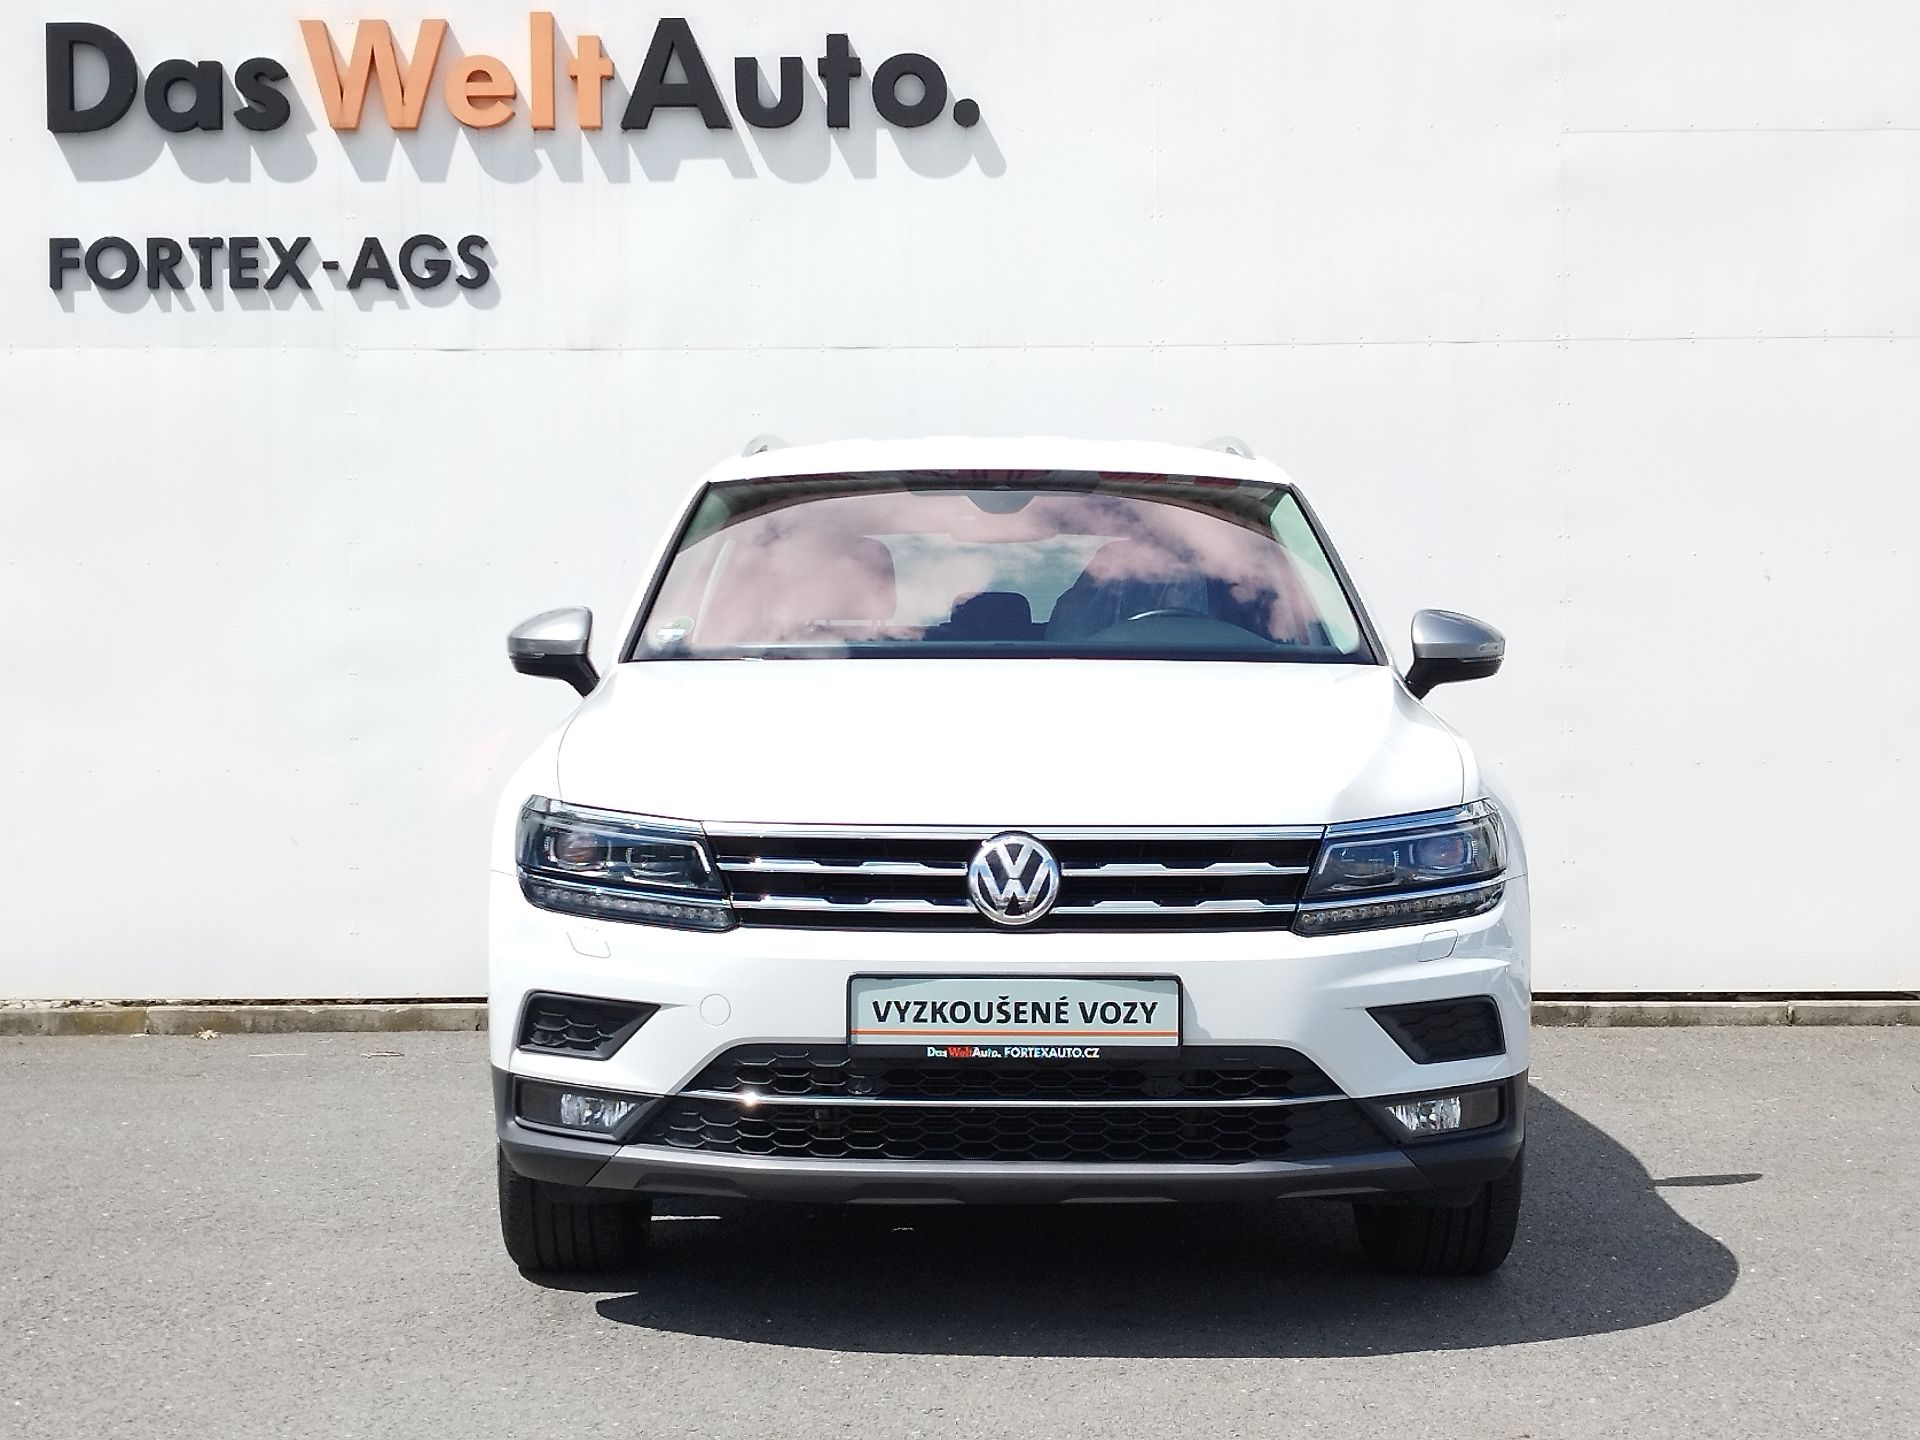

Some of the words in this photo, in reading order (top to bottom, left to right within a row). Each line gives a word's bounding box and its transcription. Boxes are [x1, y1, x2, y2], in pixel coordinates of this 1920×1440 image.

[49, 235, 490, 292] FORTEX-AGS
[871, 995, 1070, 1024] VYZKOUŠENÉ
[1078, 1001, 1159, 1024] VOZY
[1003, 1046, 1100, 1059] FORTEXAUTO.CZ
